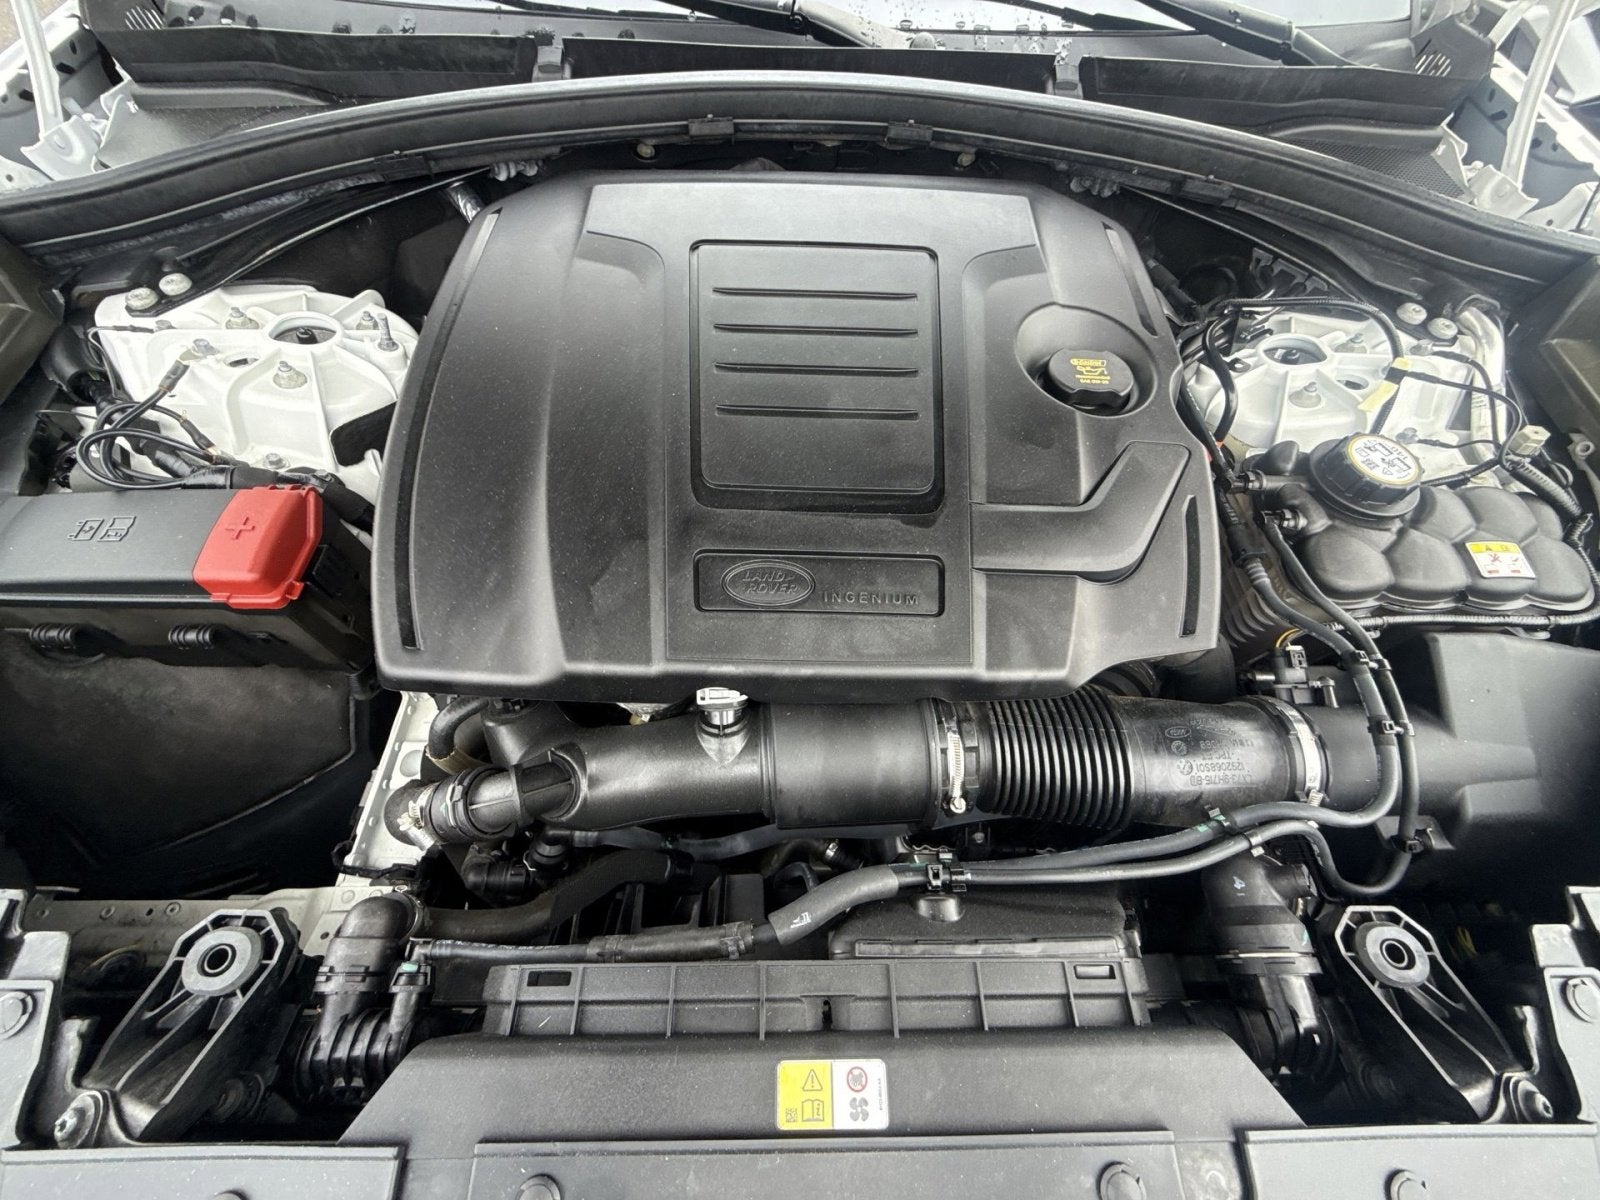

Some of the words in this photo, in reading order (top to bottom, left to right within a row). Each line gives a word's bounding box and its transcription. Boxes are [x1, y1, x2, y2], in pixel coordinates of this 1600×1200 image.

[742, 570, 788, 582] LAND
[745, 582, 798, 595] ROVER
[822, 591, 920, 606] INGENIUM
